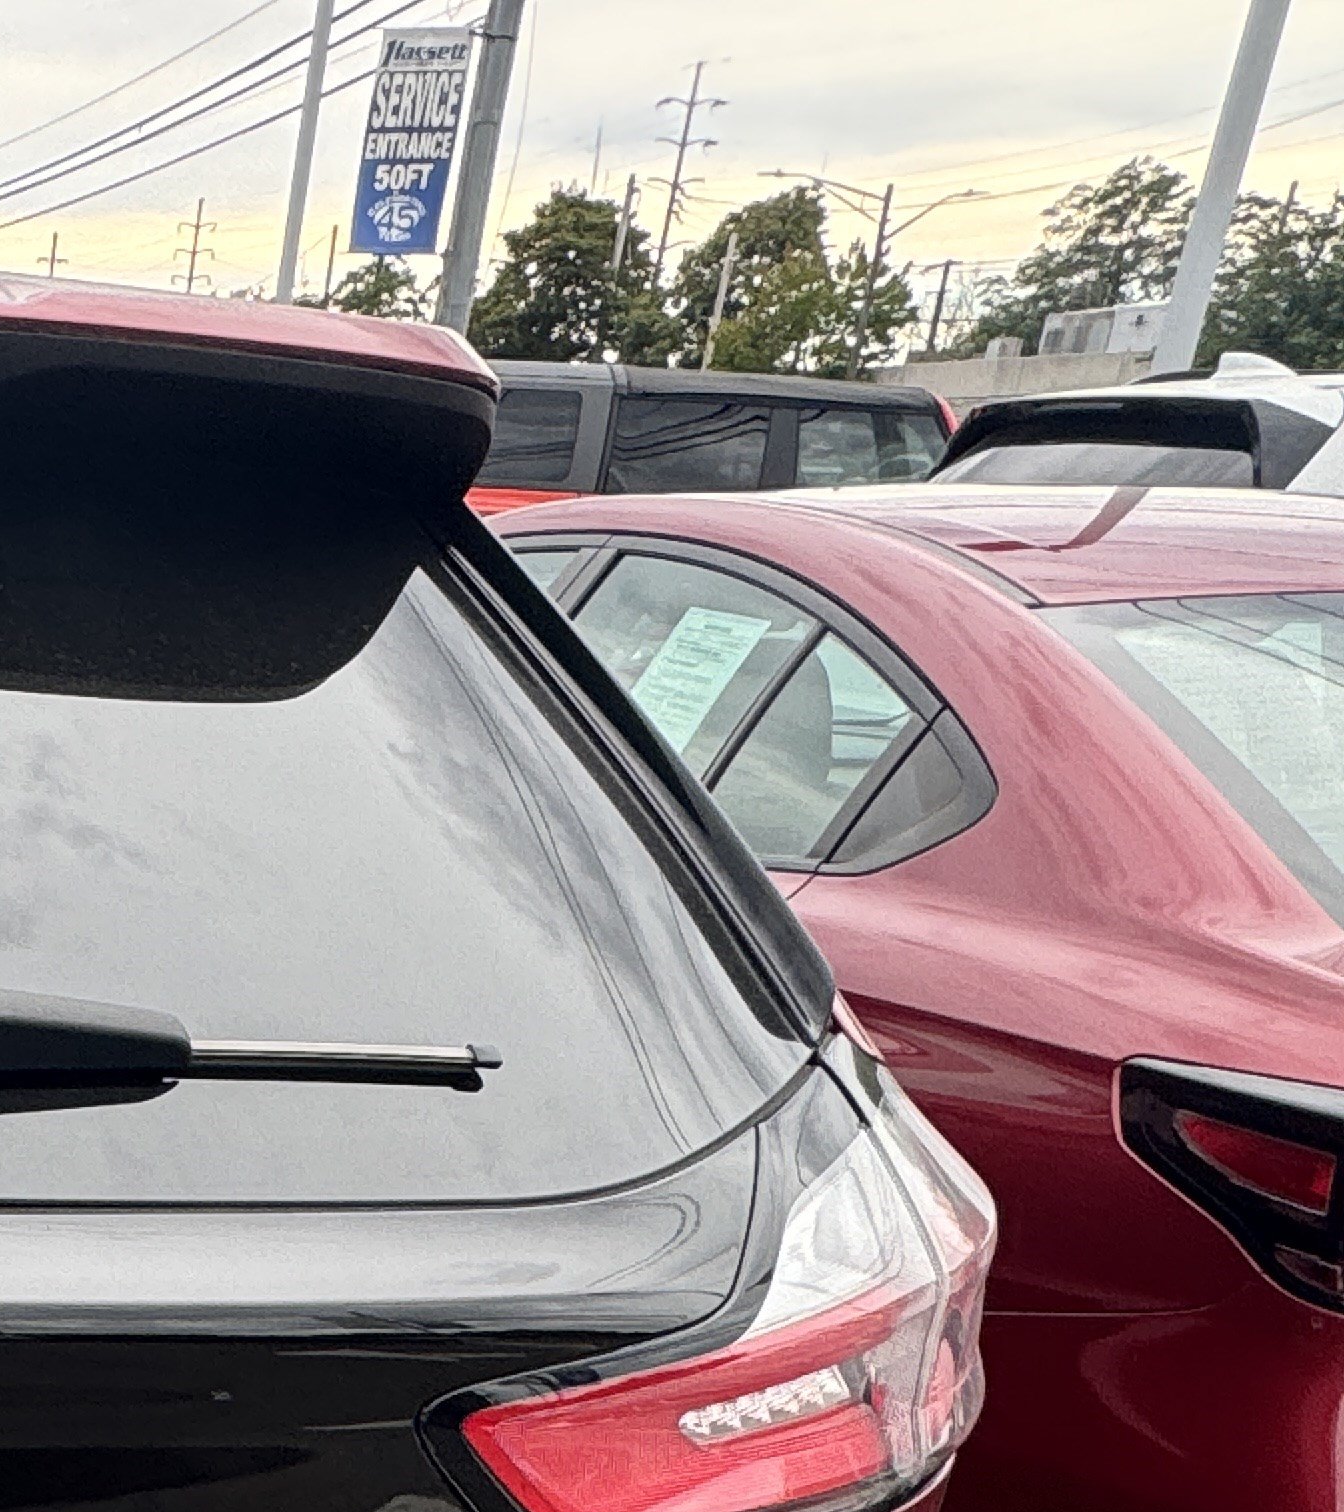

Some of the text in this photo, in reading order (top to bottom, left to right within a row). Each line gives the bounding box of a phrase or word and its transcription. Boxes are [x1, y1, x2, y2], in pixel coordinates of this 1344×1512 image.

[370, 71, 463, 129] SERVICE
[364, 131, 454, 160] ENTRANCE
[373, 163, 435, 192] 50FT
